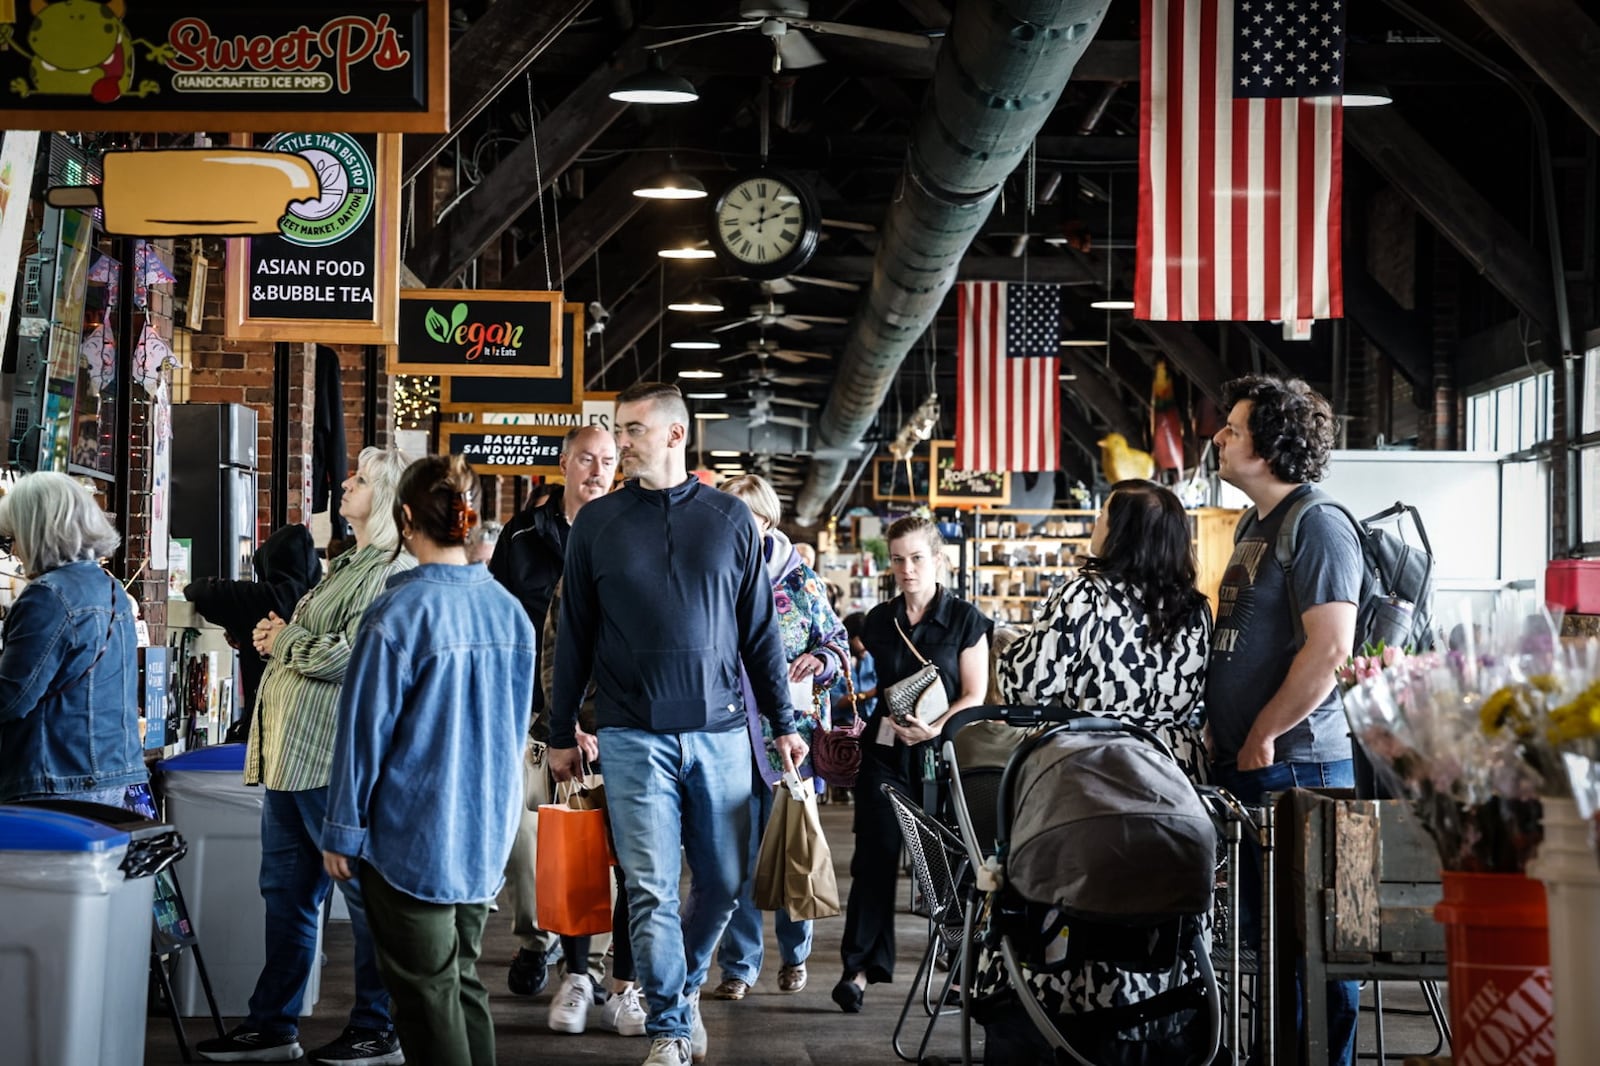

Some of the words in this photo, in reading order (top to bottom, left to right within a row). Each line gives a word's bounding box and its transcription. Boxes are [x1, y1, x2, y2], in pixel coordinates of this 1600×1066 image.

[167, 17, 321, 72] Sweet
[317, 13, 410, 95] P's
[177, 76, 270, 88] HANDCRAFTED
[271, 77, 293, 88] ICE
[294, 77, 327, 88] POPS
[279, 134, 313, 152] STYLE
[315, 134, 342, 152] THAI
[339, 146, 366, 186] BISTRO
[337, 195, 363, 226] DAYTON
[256, 258, 311, 275] ASIAN
[315, 260, 366, 277] FOOD
[251, 284, 336, 302] &BUBBLE
[339, 286, 374, 303] TEA
[425, 302, 524, 361] Vegan
[500, 346, 517, 357] Eats
[483, 434, 539, 446] BAGELS
[463, 444, 559, 456] SANDWICHES
[487, 455, 535, 466] SOUPS
